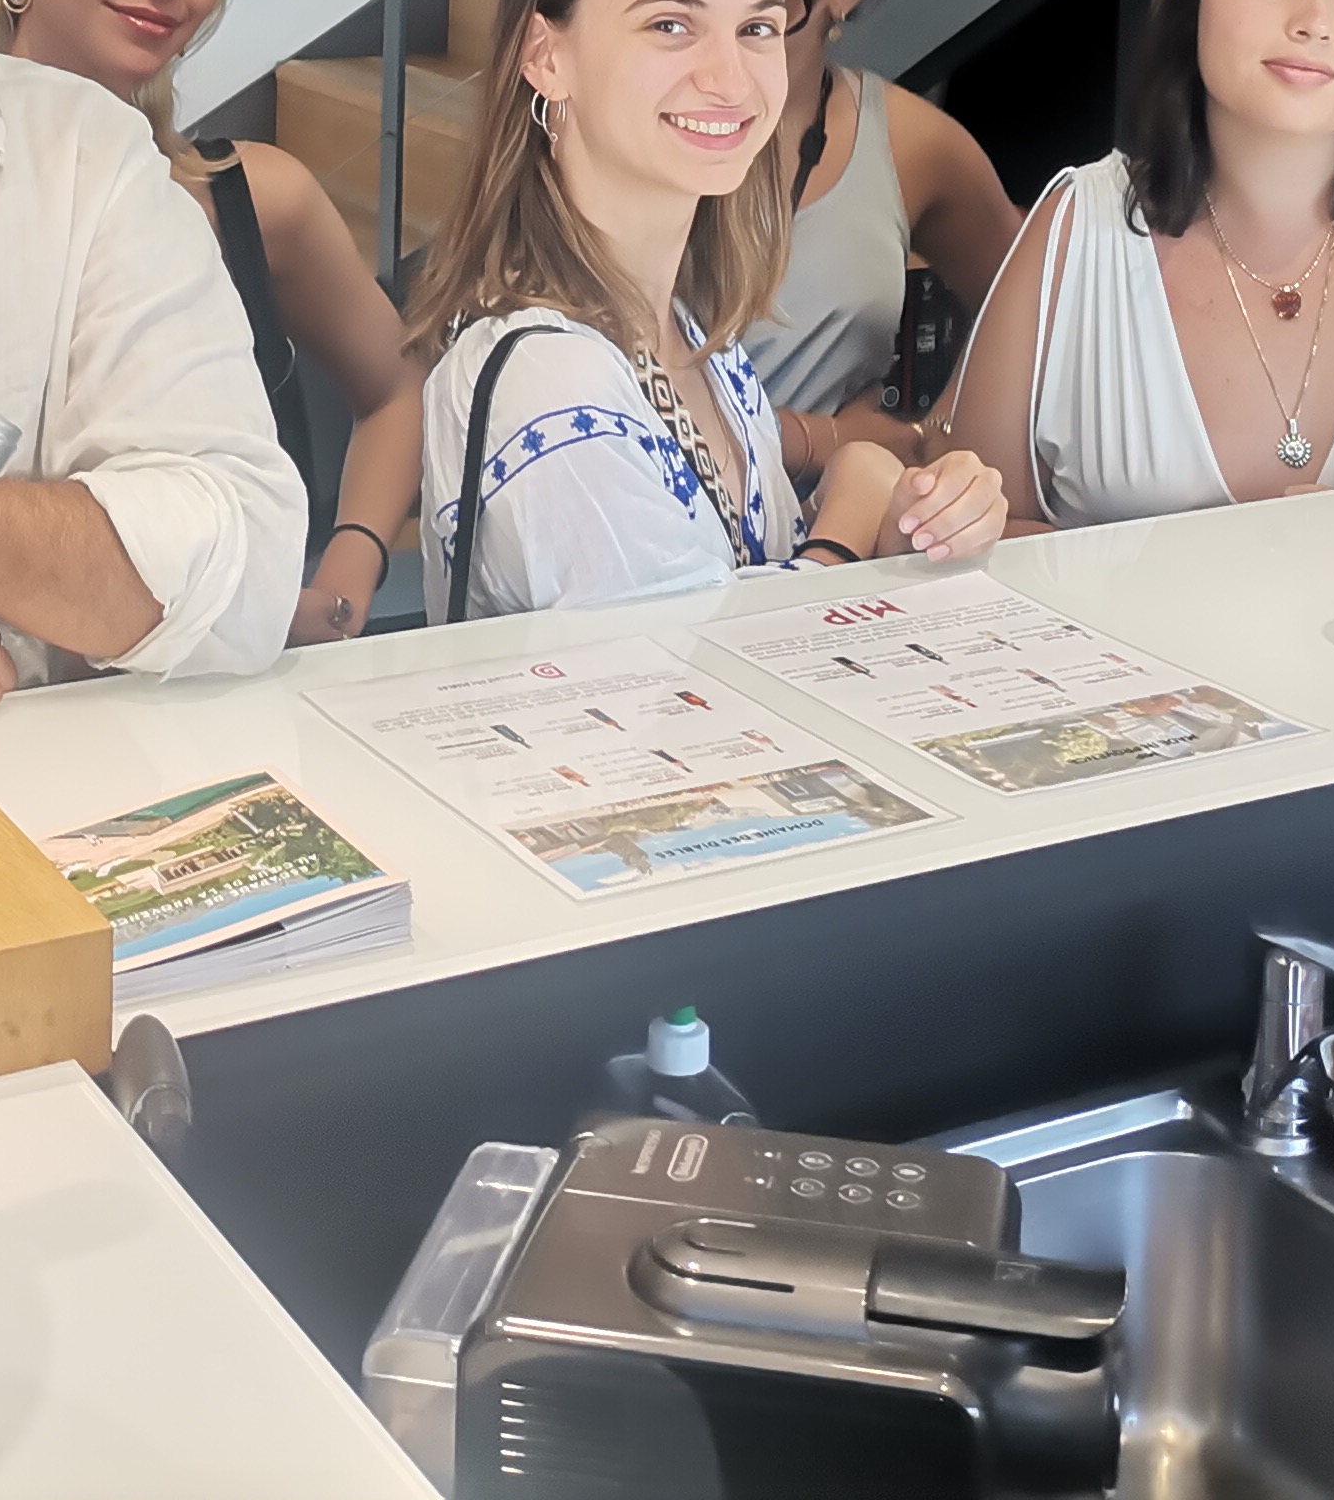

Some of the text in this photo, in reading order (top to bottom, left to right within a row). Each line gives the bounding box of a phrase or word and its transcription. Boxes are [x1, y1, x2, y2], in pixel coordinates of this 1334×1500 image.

[655, 818, 825, 860] DOMAINE DES DIABLES
